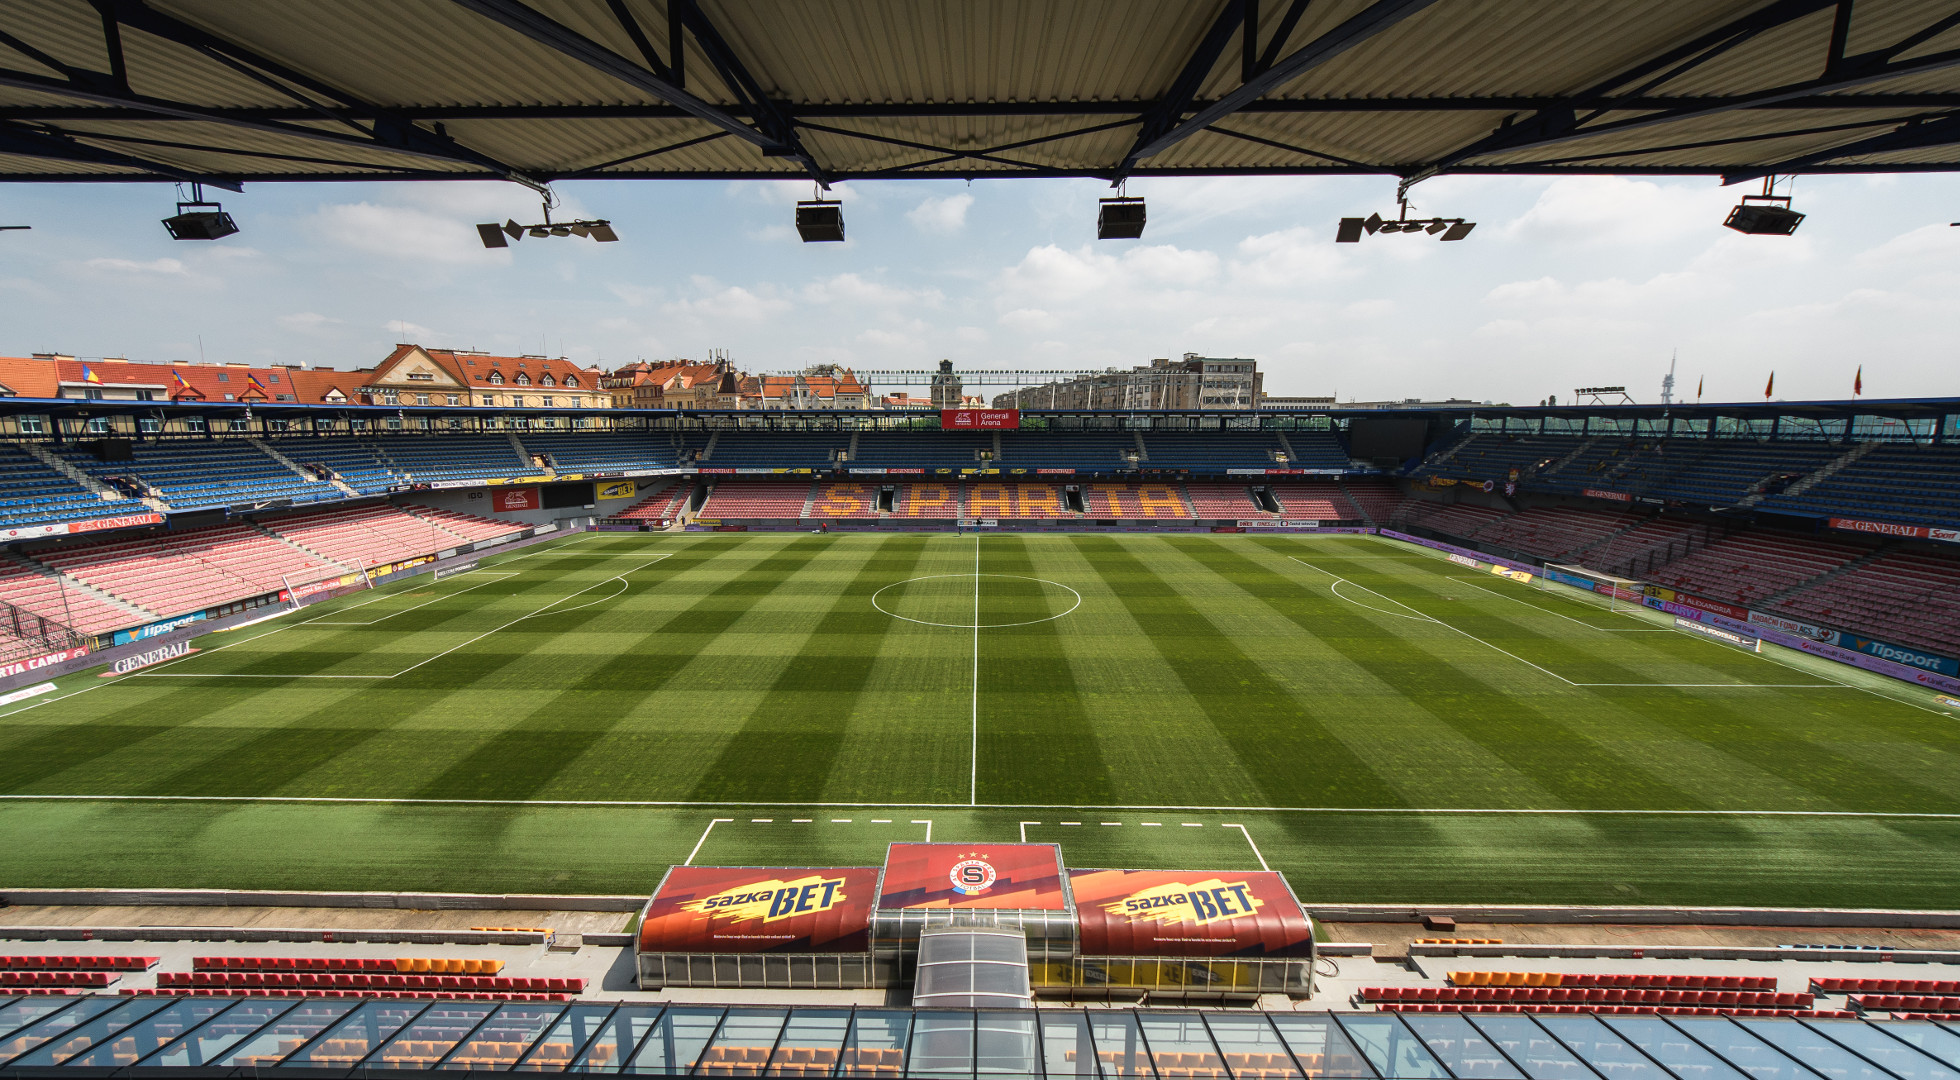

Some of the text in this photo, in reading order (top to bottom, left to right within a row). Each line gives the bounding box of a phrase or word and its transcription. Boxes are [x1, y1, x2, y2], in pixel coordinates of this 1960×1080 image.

[980, 412, 1009, 420] Generali
[821, 483, 1186, 516] SPARTA
[1594, 490, 1627, 501] GENERALI
[97, 514, 152, 529] GENERALI
[1856, 521, 1918, 537] GENERALI
[1931, 529, 1957, 539] Sport
[1666, 603, 1701, 620] BARVY
[1686, 598, 1731, 614] ALEXANDRIA
[143, 615, 195, 637] Tipsport
[1780, 620, 1798, 631] FOND
[29, 652, 68, 671] CAMP
[114, 640, 193, 673] GENERALI
[1872, 641, 1941, 669] Tipsport
[963, 867, 983, 882] S
[767, 881, 842, 918] BET
[1188, 884, 1253, 921] BET
